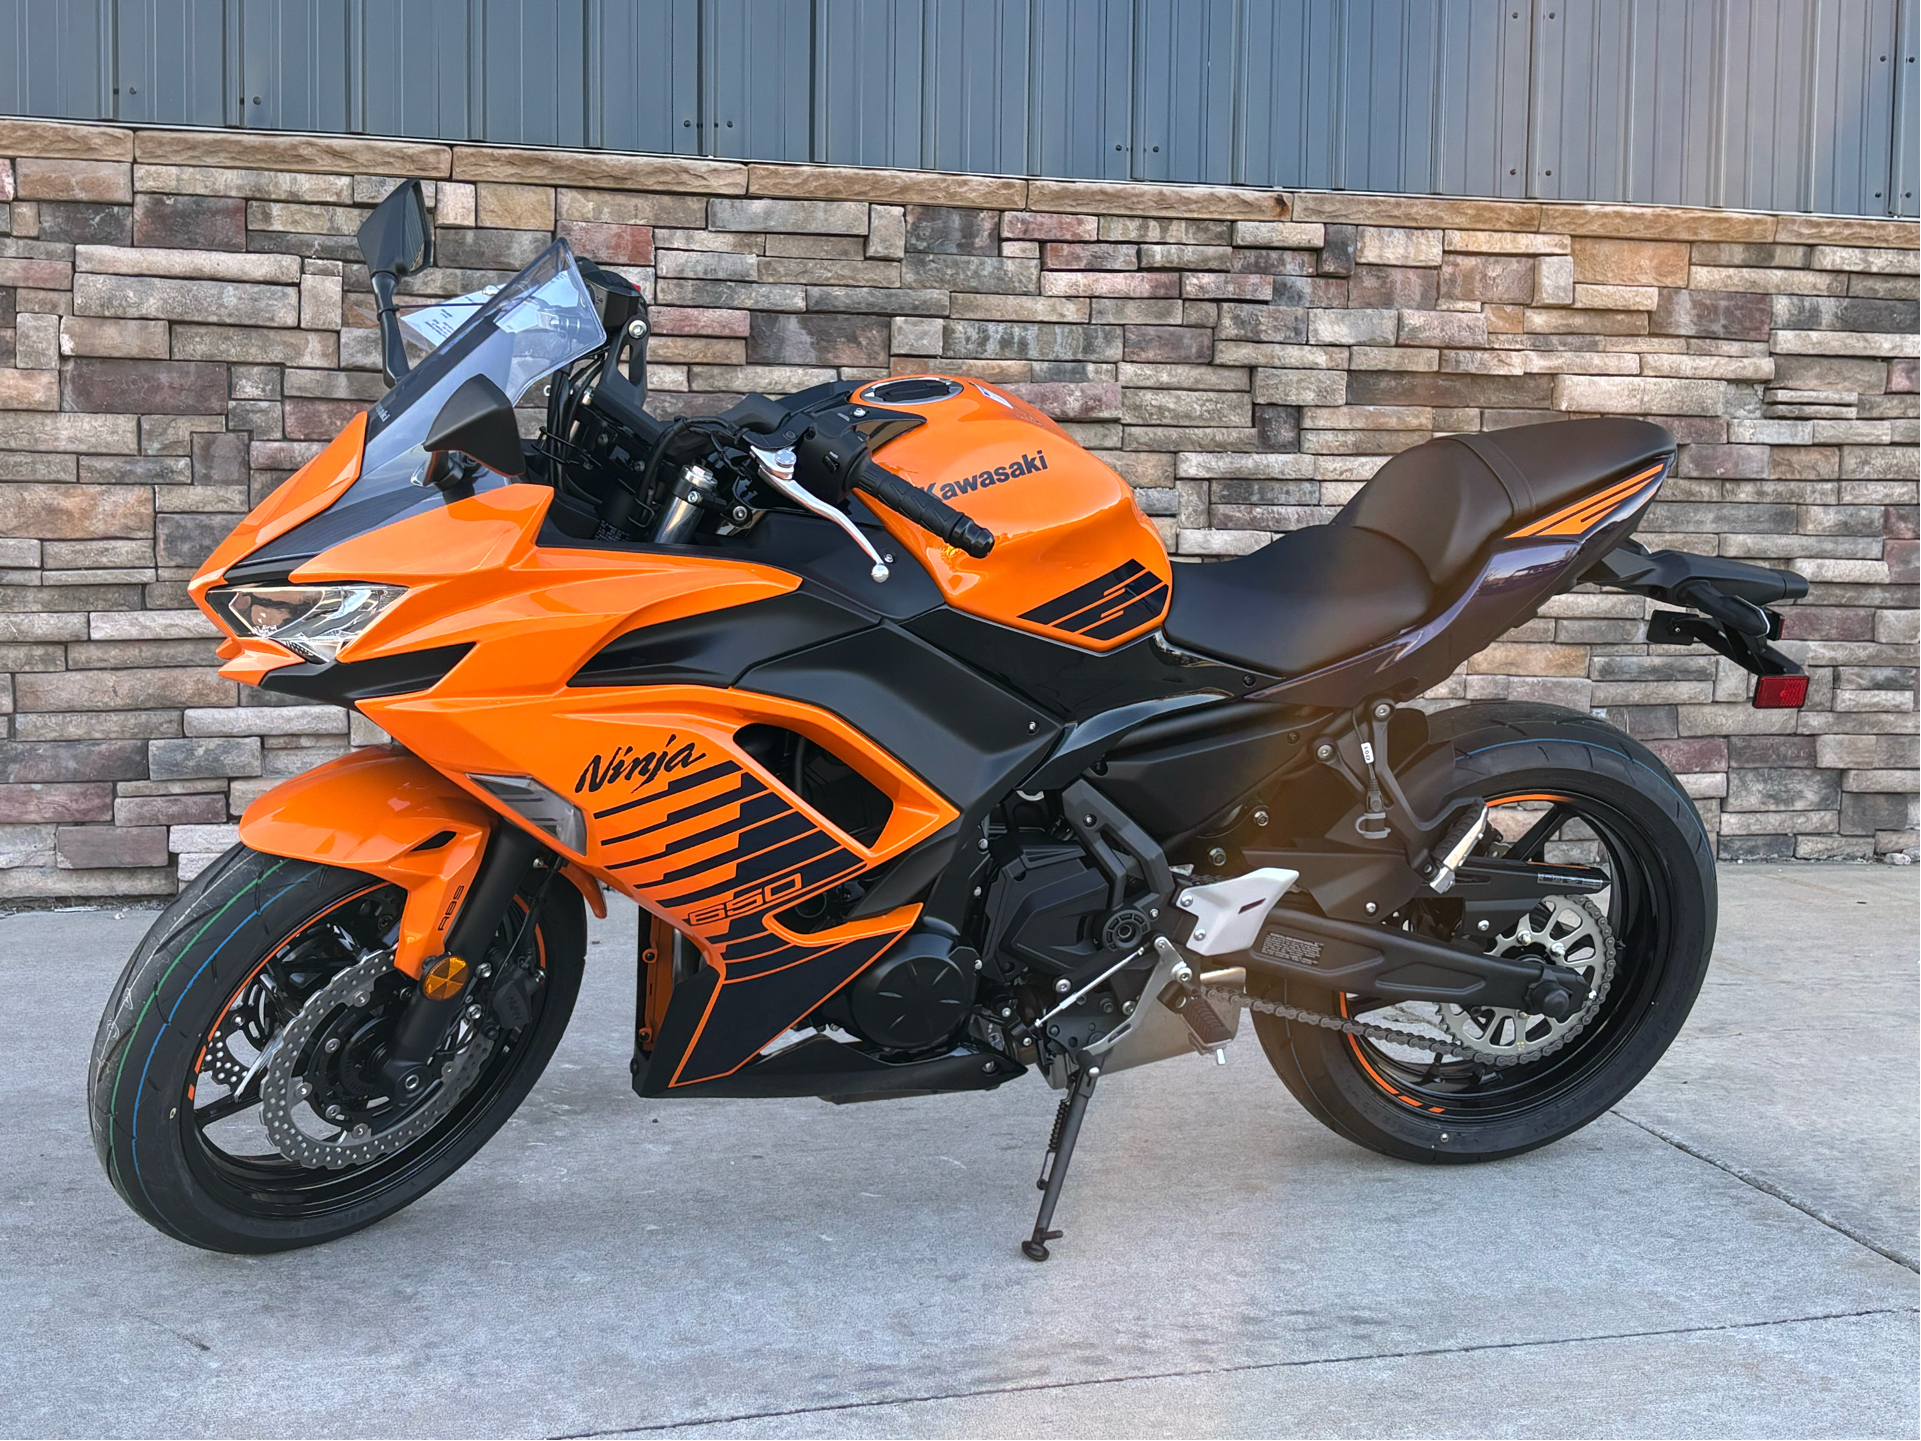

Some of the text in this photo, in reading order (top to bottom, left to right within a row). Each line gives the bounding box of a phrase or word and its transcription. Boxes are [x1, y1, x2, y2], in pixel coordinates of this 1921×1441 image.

[575, 734, 706, 793] Ninja
[438, 885, 465, 931] ABS
[687, 873, 802, 926] 650
